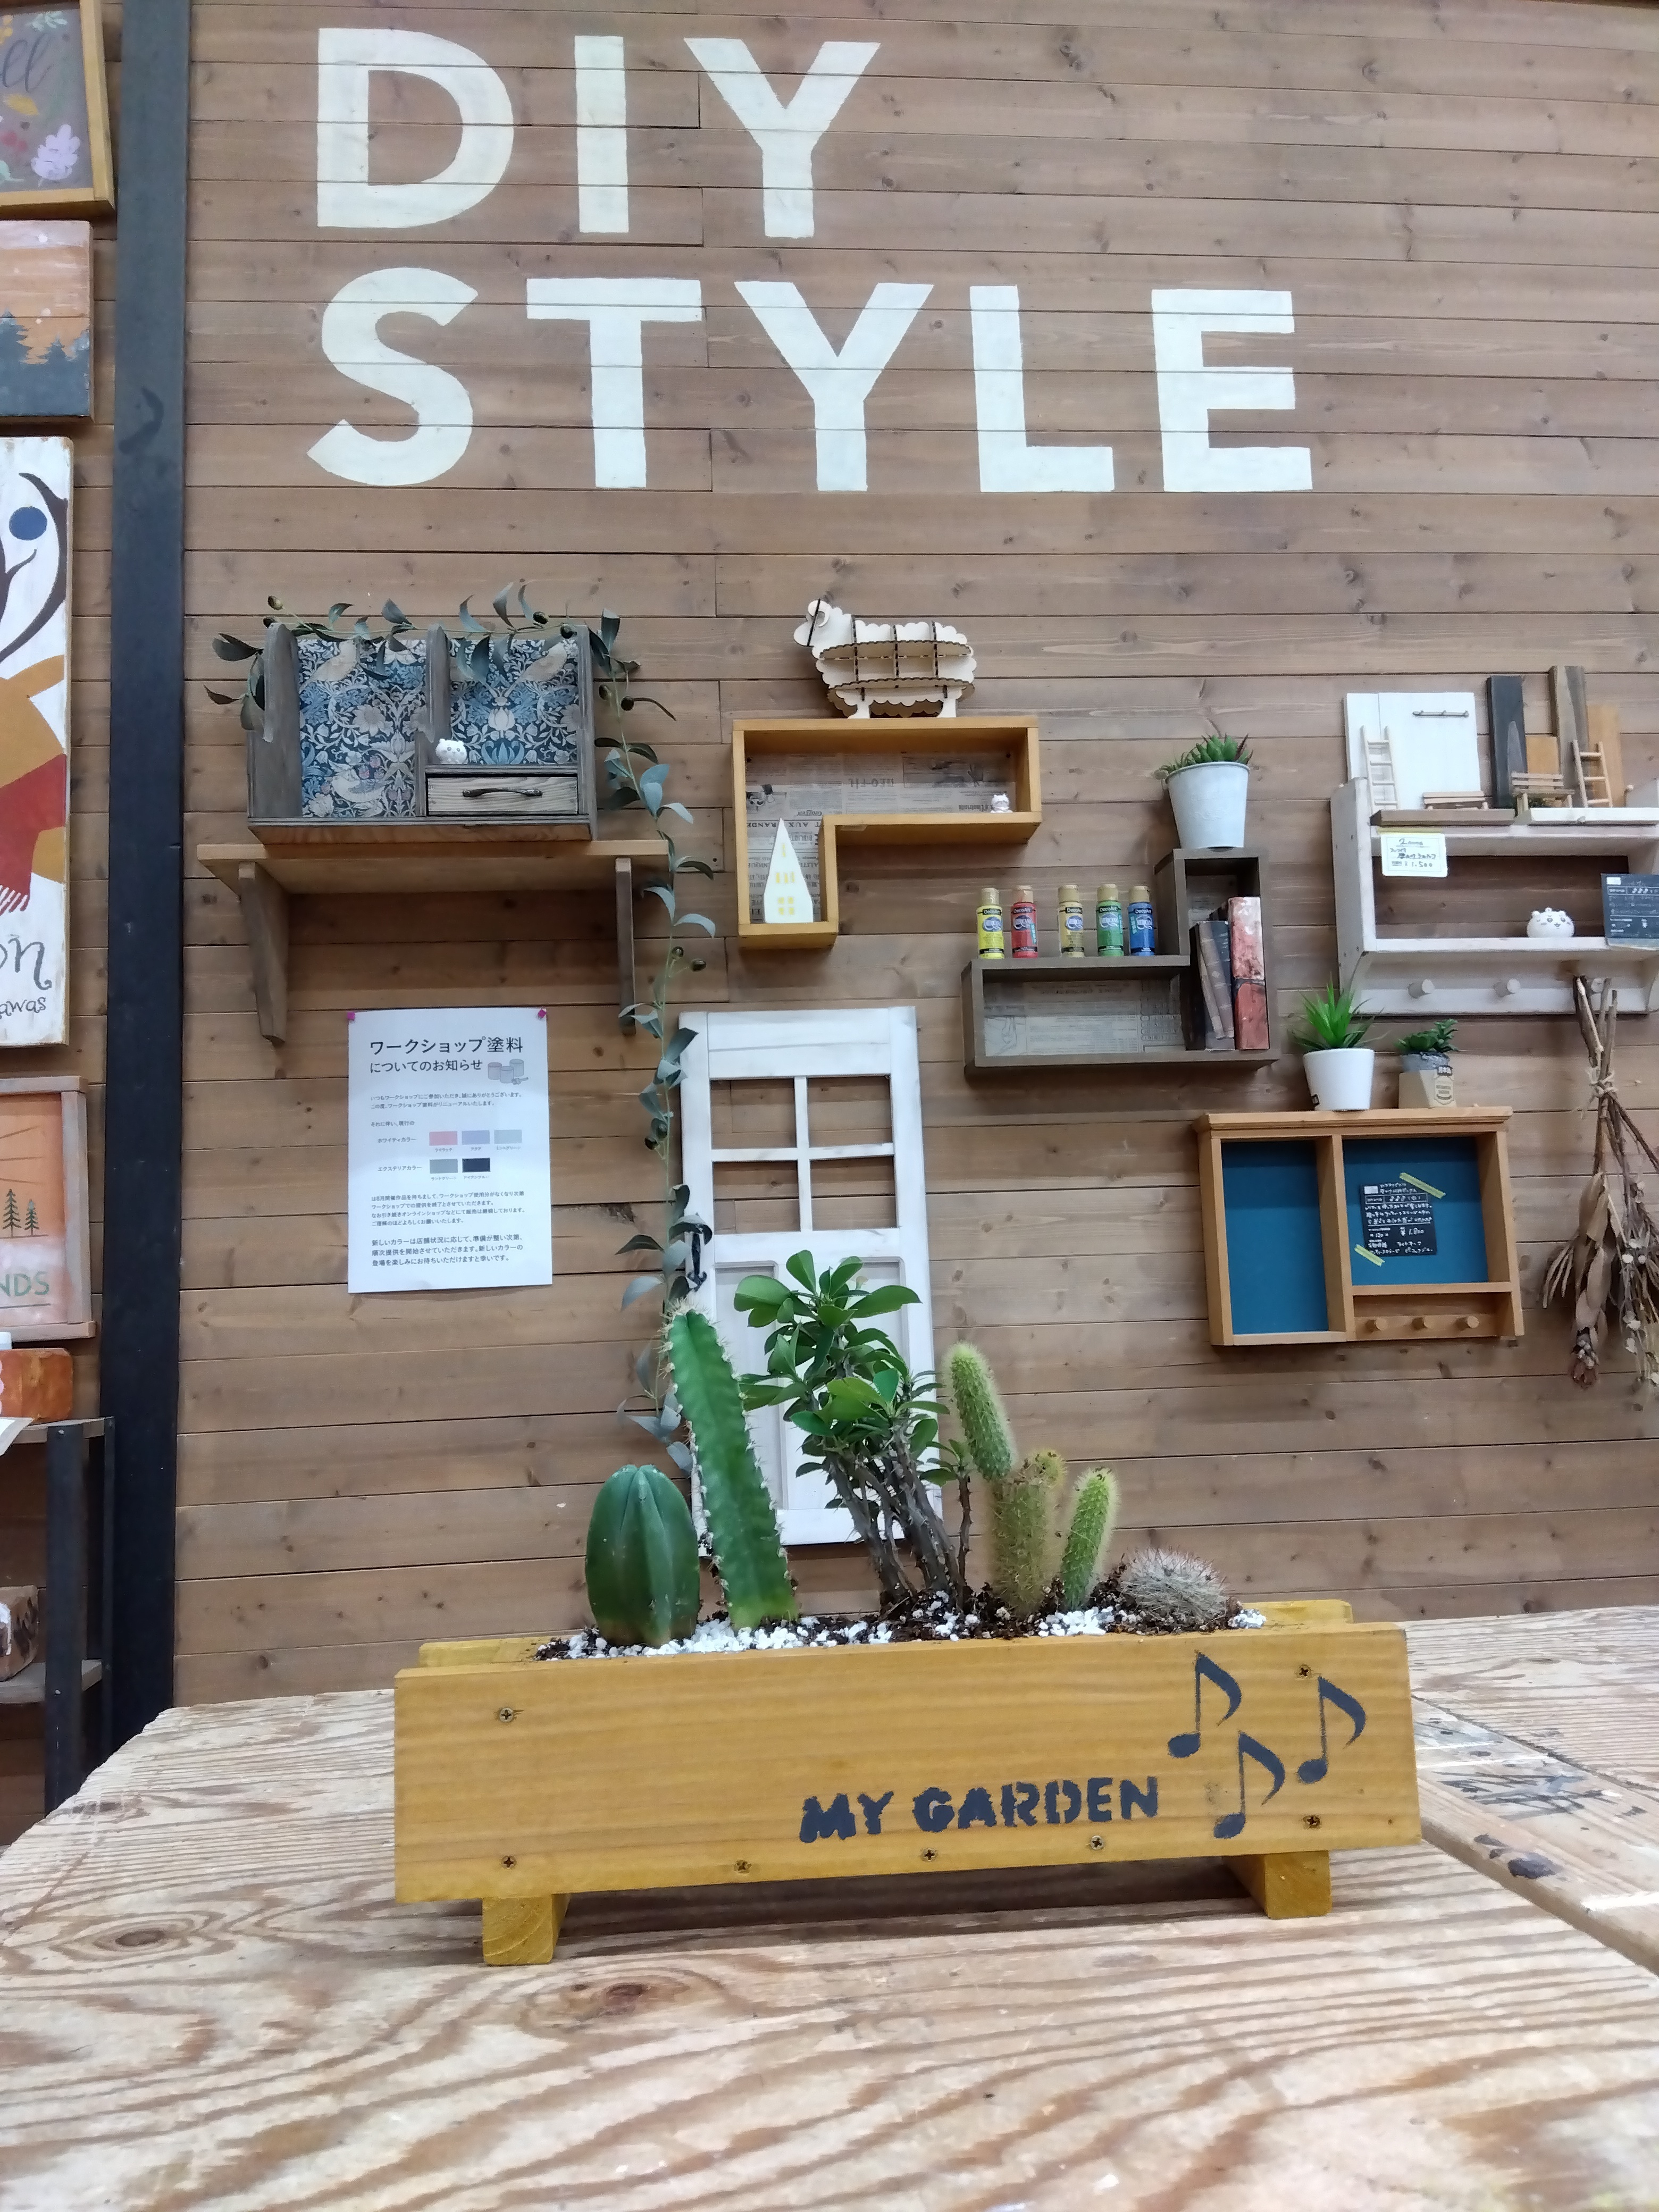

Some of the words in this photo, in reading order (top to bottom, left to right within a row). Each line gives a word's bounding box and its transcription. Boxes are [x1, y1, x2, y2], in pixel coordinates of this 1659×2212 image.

[317, 28, 881, 238] DIY
[307, 267, 1313, 492] STYLE
[370, 1036, 523, 1055] ワークショップ塗料
[370, 1059, 483, 1073] についてのお知らせ
[372, 1244, 523, 1256] 順次提供を開始させていただきます。新しいカラーの
[372, 1254, 509, 1267] 登場を楽しみにお待ちいただけますと幸いです。
[799, 1791, 894, 1844] MY
[912, 1777, 1159, 1833] GARDEN
